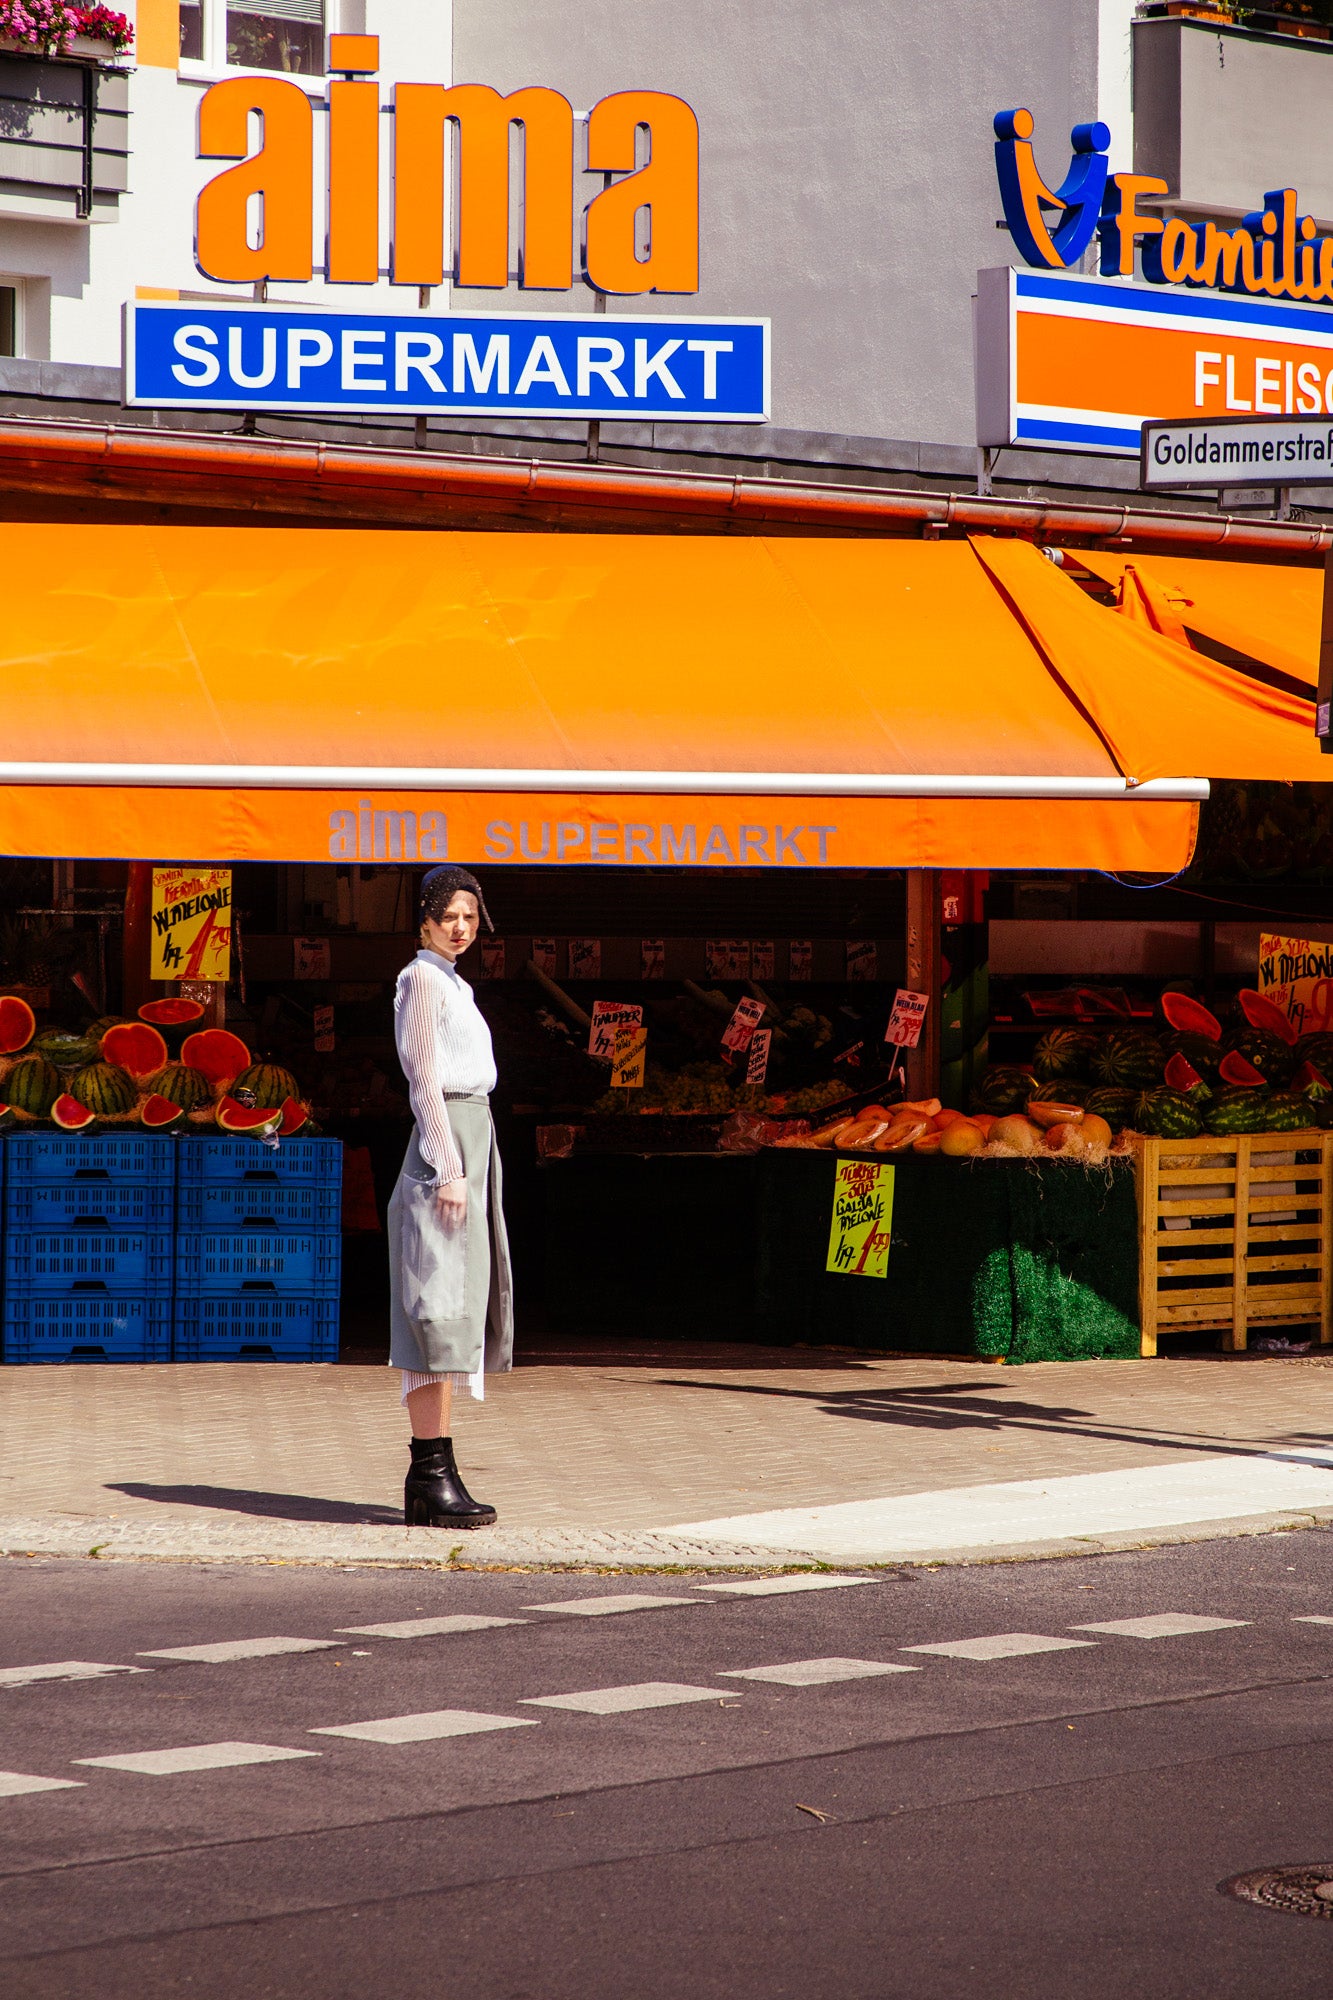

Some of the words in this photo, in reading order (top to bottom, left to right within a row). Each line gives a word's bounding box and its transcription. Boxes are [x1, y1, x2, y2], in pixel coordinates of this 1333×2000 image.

[194, 33, 699, 294] aima
[170, 325, 734, 400] SUPERMARKT
[329, 800, 448, 859] aima
[484, 820, 837, 863] SUPERMARKT
